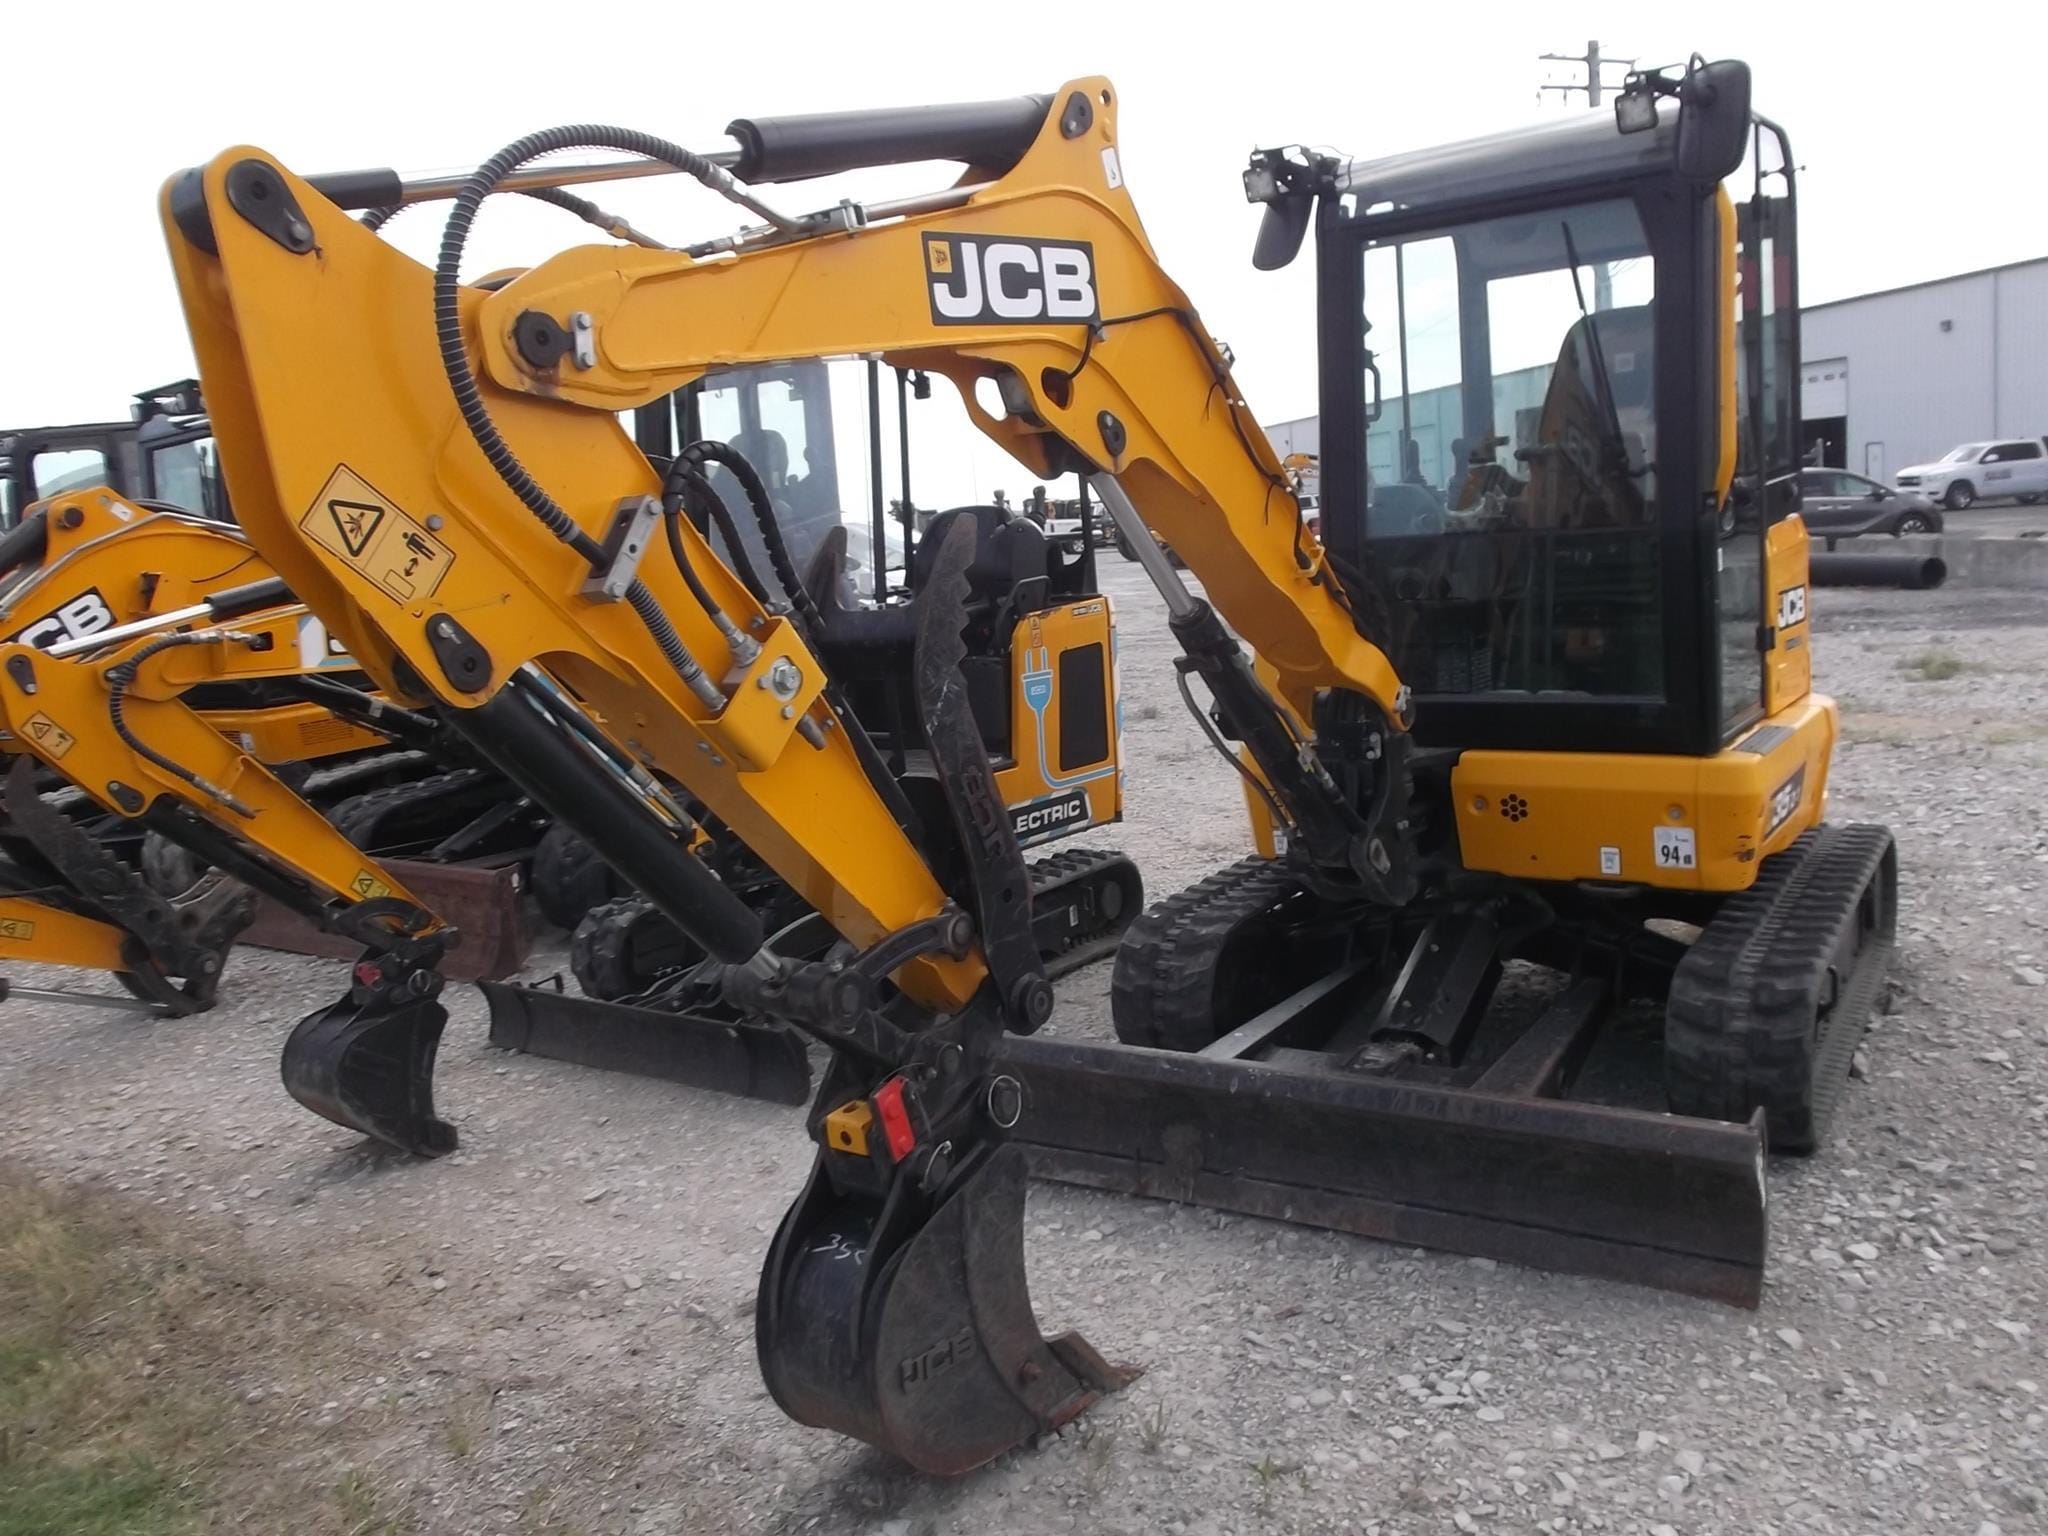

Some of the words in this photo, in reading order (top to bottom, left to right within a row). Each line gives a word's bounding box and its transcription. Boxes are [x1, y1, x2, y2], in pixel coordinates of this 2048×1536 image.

[932, 241, 1096, 318] JCB
[18, 593, 112, 652] CB
[1778, 587, 1806, 628] JCB
[1013, 799, 1082, 835] ECTRIC
[1661, 845, 1680, 864] 94
